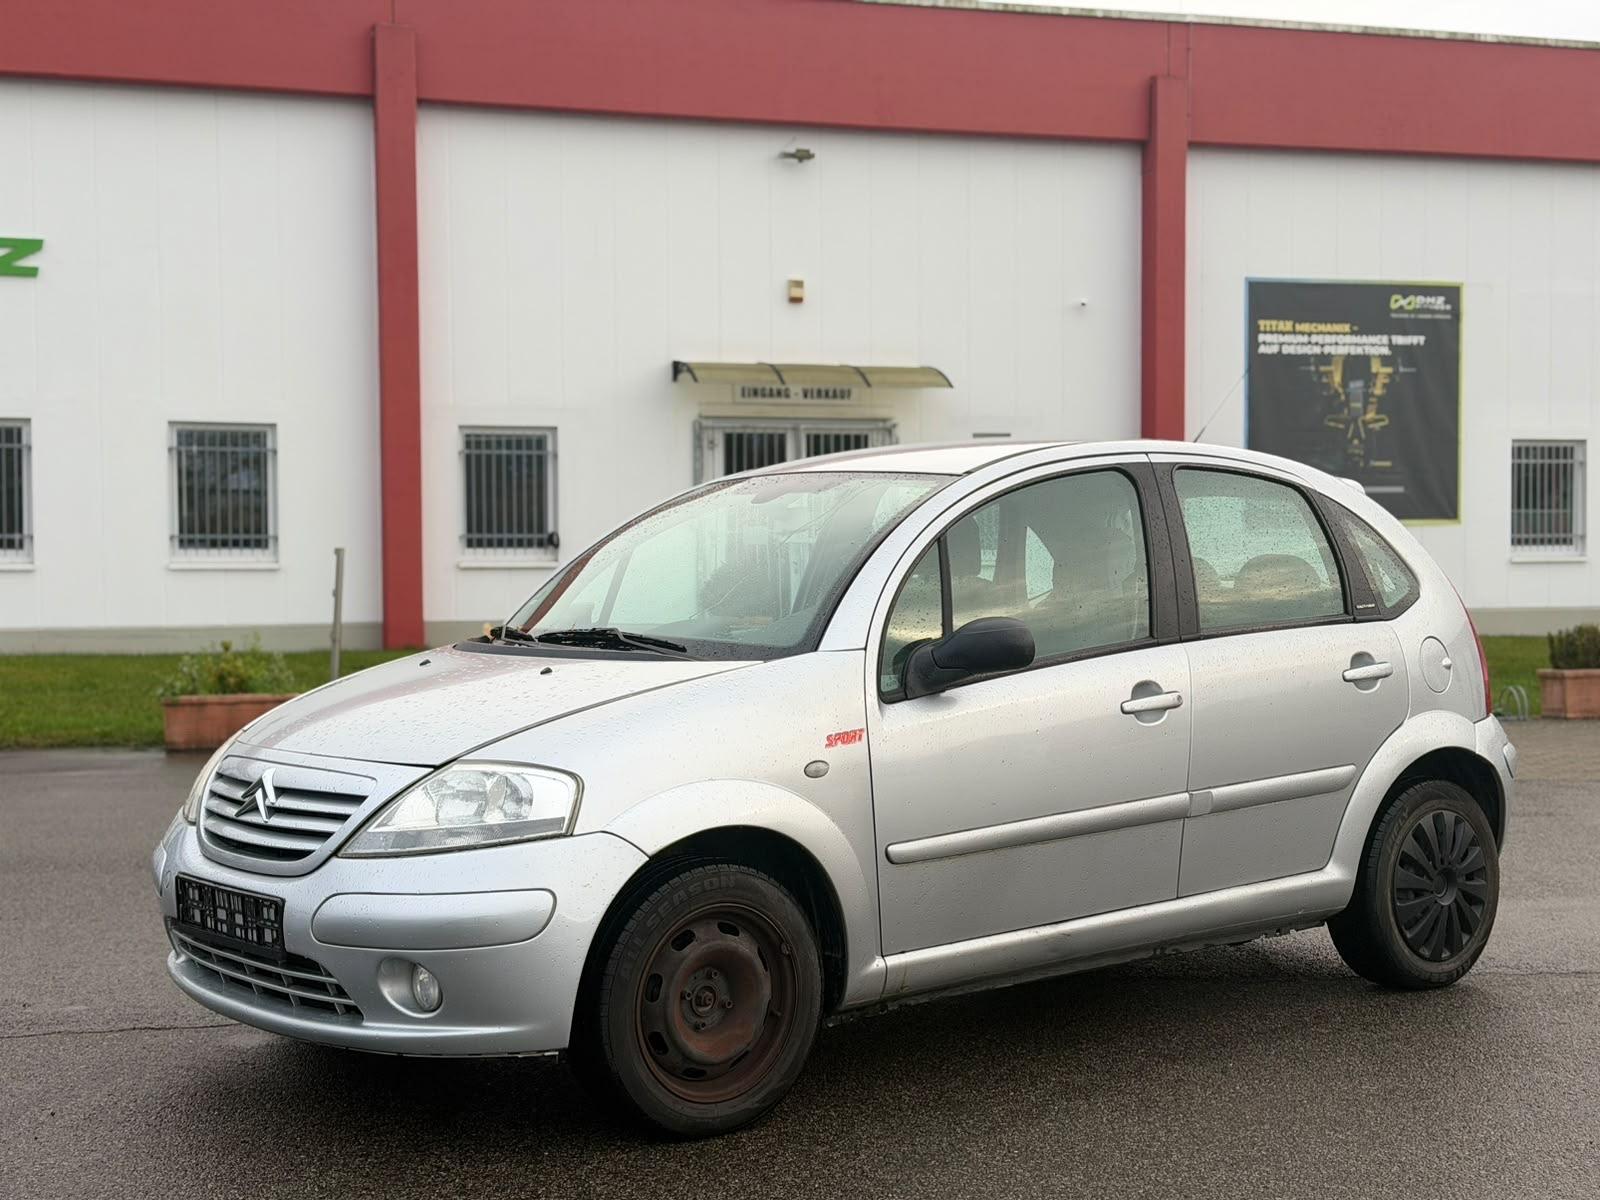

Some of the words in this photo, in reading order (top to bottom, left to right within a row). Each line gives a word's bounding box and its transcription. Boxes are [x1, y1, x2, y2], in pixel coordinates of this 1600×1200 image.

[1257, 344, 1280, 355] AUF
[741, 386, 791, 399] EINGANG
[802, 387, 852, 400] VERKAUF
[825, 728, 865, 750] SPORT
